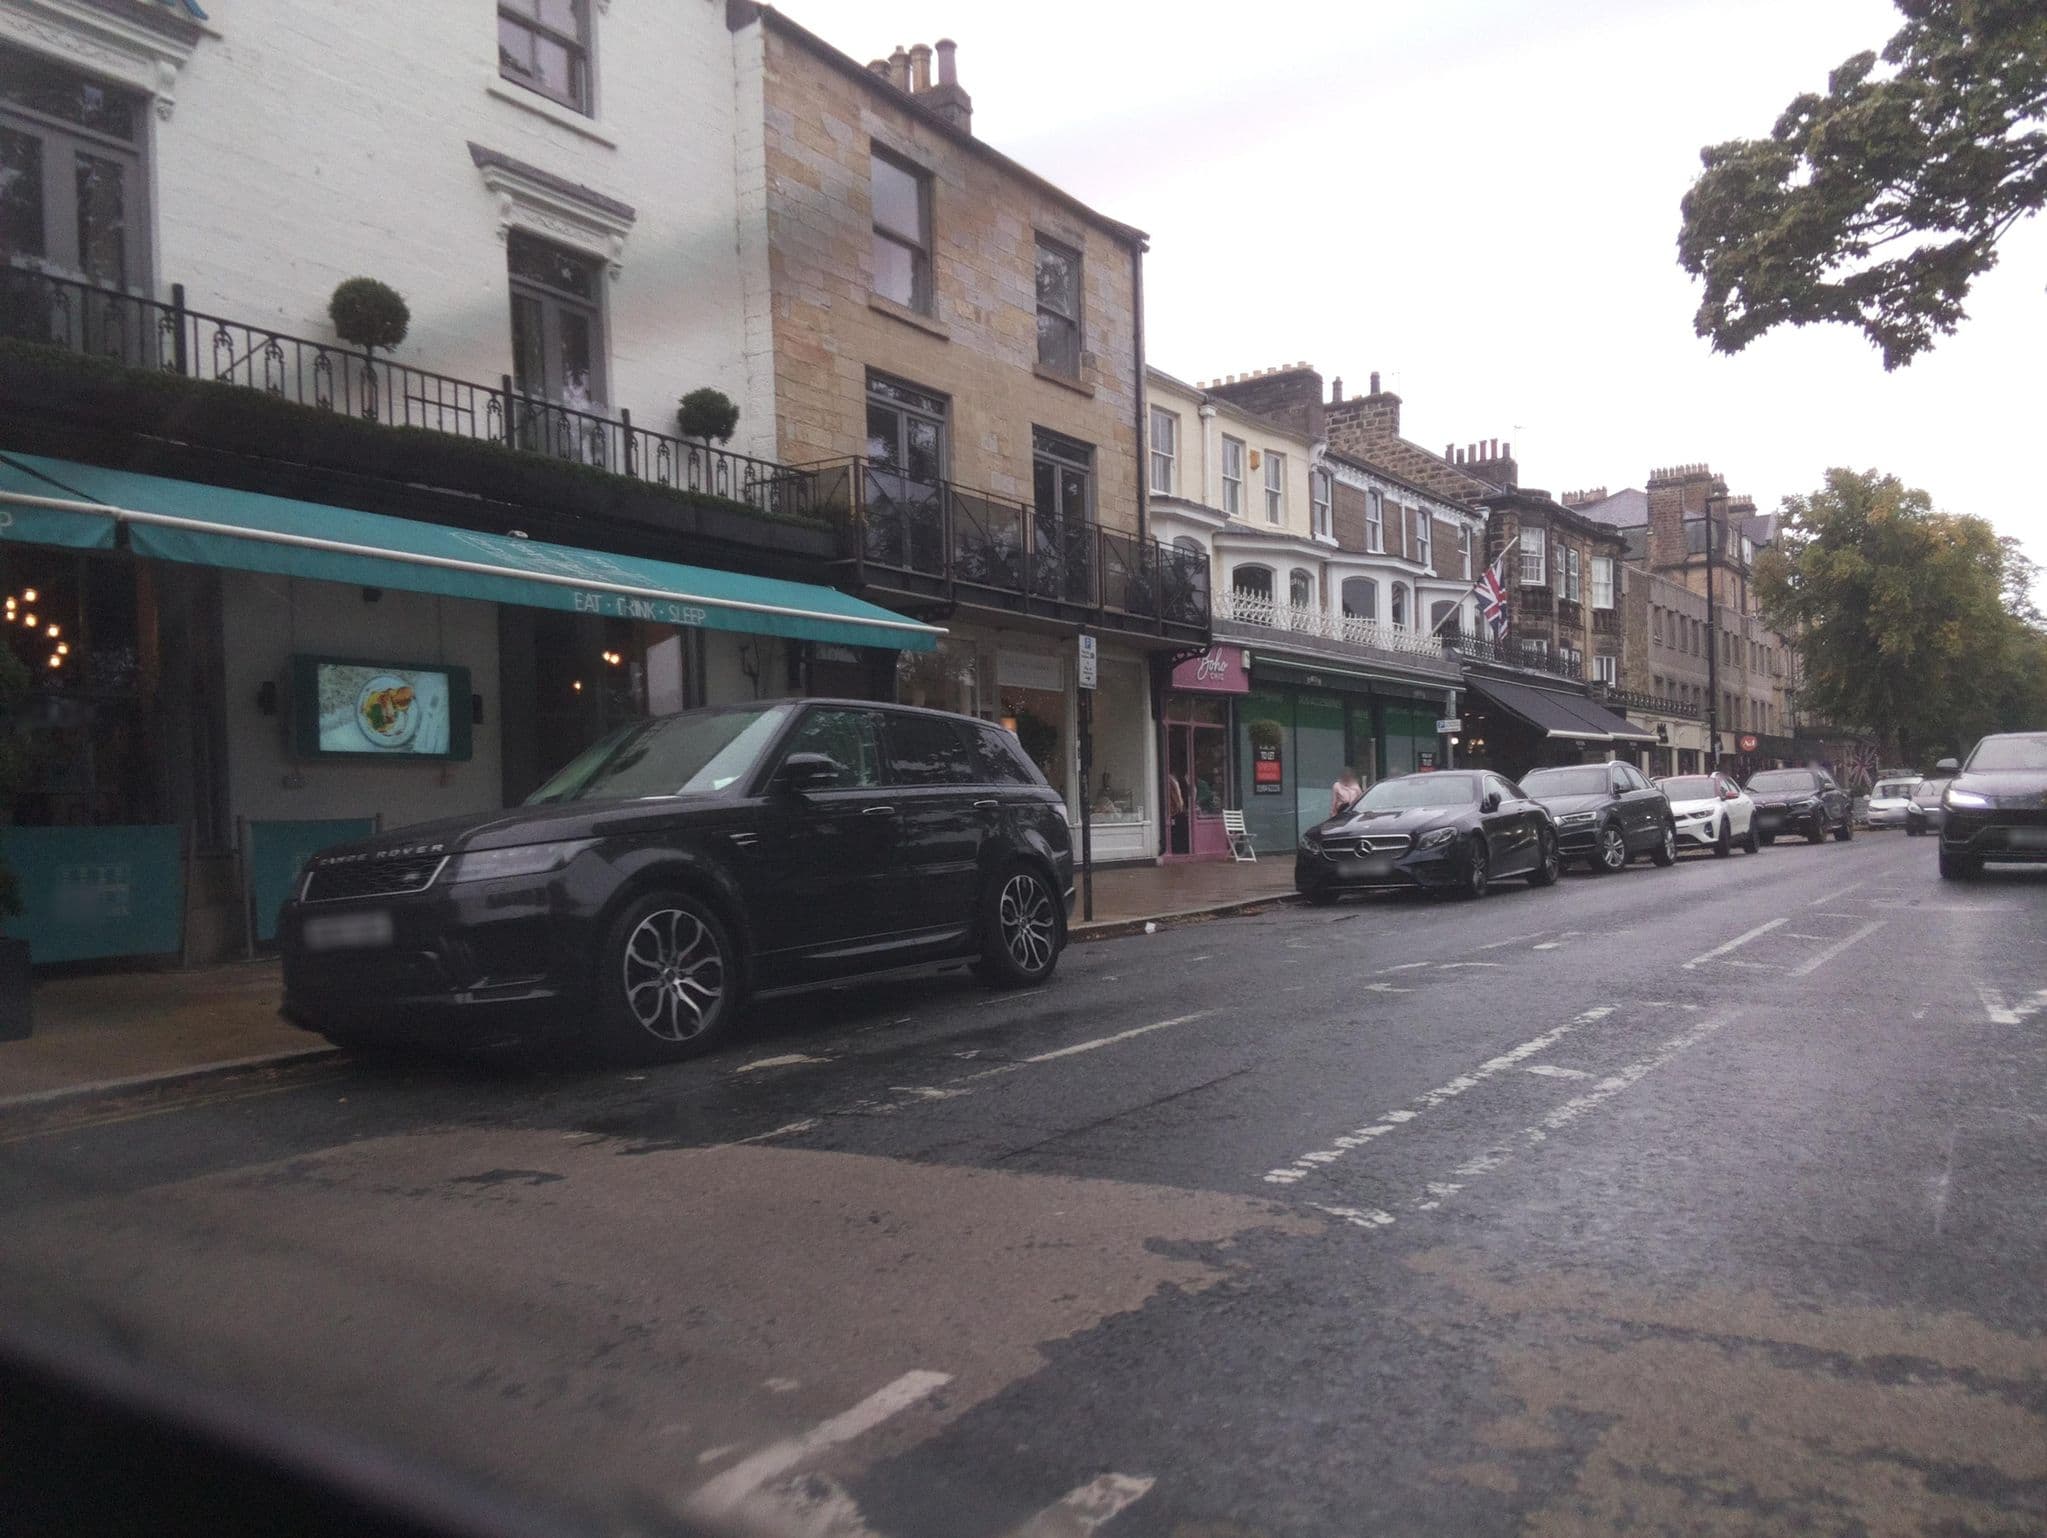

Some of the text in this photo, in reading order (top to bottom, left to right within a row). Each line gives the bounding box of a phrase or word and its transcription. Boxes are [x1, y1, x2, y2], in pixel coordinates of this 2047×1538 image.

[574, 591, 602, 613] EAT
[668, 604, 706, 625] SLEEP
[376, 844, 444, 859] ROVER
